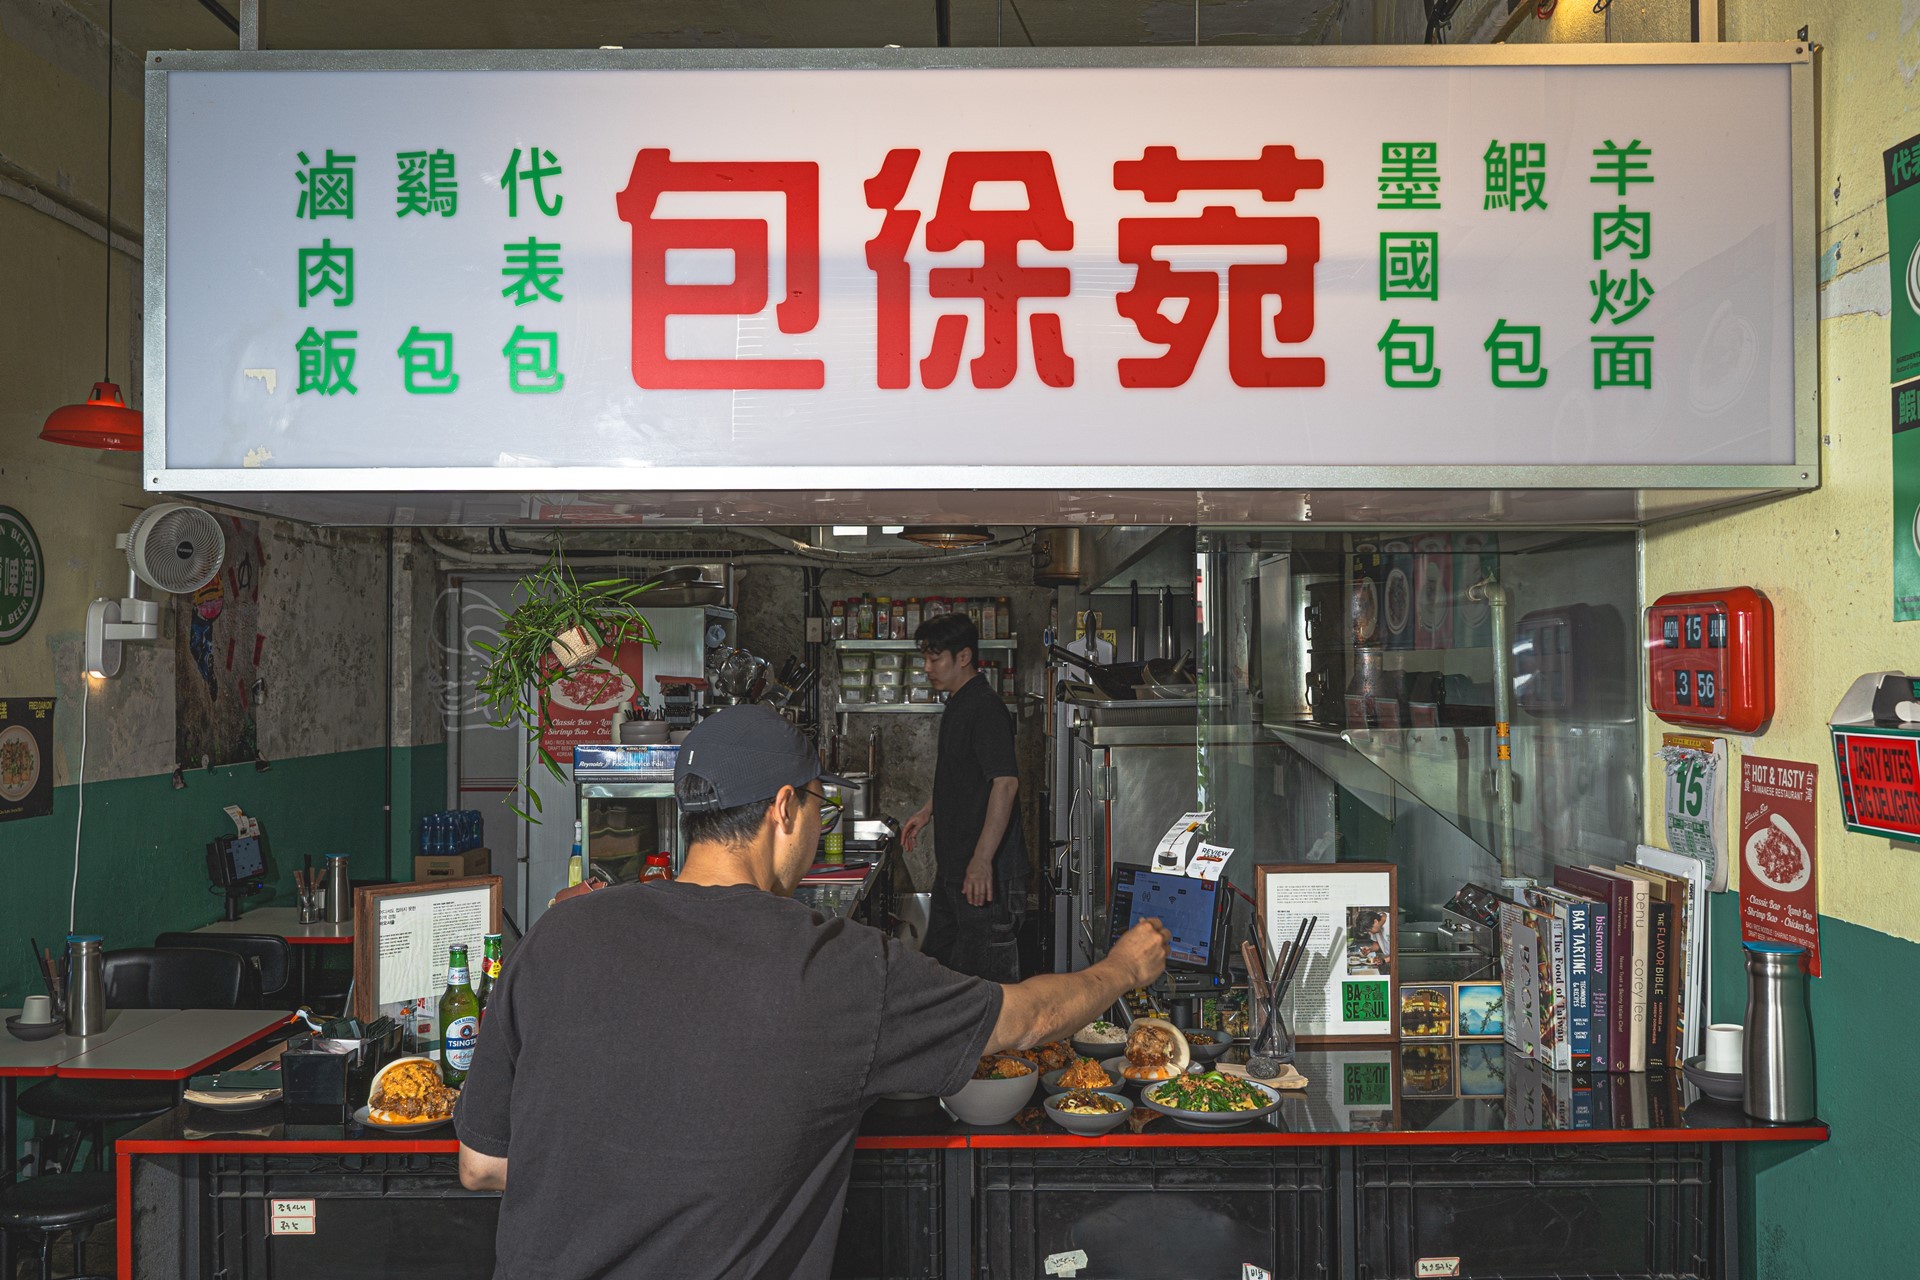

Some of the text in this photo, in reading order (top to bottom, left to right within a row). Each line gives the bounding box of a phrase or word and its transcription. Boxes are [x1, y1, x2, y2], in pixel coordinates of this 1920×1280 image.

[295, 148, 359, 397] 滷肉飯
[501, 146, 565, 395] 代表包
[616, 145, 1325, 389] 包徐苑
[1377, 141, 1441, 389] 墨國包
[1589, 139, 1655, 390] 羊肉炒面
[10, 528, 31, 557] BEER
[8, 599, 29, 625] BEER
[1664, 617, 1726, 640] MON 15 JUN
[1679, 672, 1714, 698] 3 56
[552, 718, 576, 726] Classic
[577, 718, 592, 726] Bao
[1752, 764, 1805, 789] HOT & TASTY
[1852, 745, 1884, 781] TASTY
[1883, 748, 1913, 785] BITES
[1676, 761, 1704, 816] 15
[1775, 788, 1803, 801] RESTAURANT
[1855, 785, 1874, 819] BIG
[1201, 847, 1230, 857] REVIEW
[1636, 892, 1649, 928] benu
[1747, 906, 1815, 935] Shrimp Bao Chicken Bao
[1749, 894, 1813, 921] Classic Bao Lamb Bao
[1554, 932, 1563, 953] The
[1571, 910, 1587, 975] BAR TARTINE
[1594, 915, 1606, 974] bistronomy
[1654, 912, 1666, 995] THE FLAVOR BIBLE
[1554, 957, 1564, 983] Food
[1519, 944, 1534, 1034] BOOK
[1555, 986, 1565, 1001] of
[1579, 980, 1587, 1008] TECHNIQUES
[1632, 959, 1646, 1022] corey lee
[1555, 1003, 1566, 1042] Taiwan
